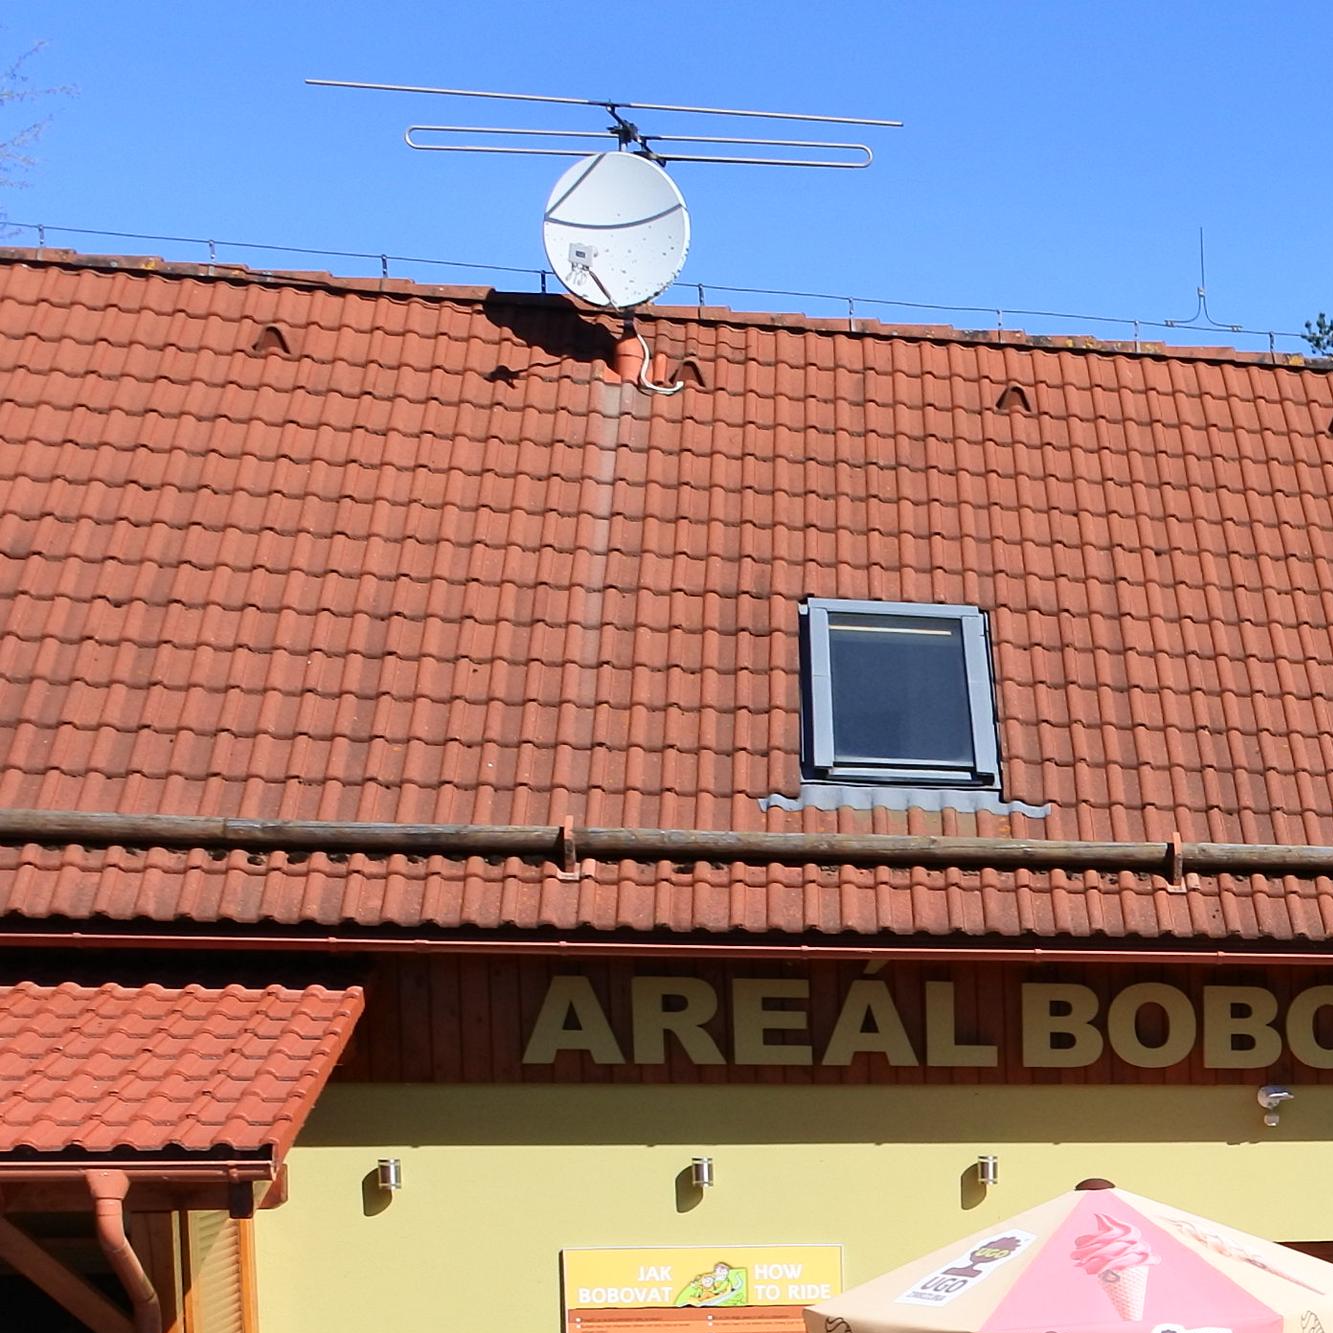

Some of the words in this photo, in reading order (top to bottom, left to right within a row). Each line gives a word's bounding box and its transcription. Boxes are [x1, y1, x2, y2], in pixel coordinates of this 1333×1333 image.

[522, 959, 998, 1066] AREÁL
[975, 1247, 1009, 1258] UGO
[637, 1265, 672, 1281] JAK
[755, 1264, 802, 1280] HOW
[754, 1285, 780, 1300] TO
[788, 1284, 831, 1300] RIDE
[920, 1276, 968, 1293] UGO
[579, 1286, 672, 1303] BOBOVAT
